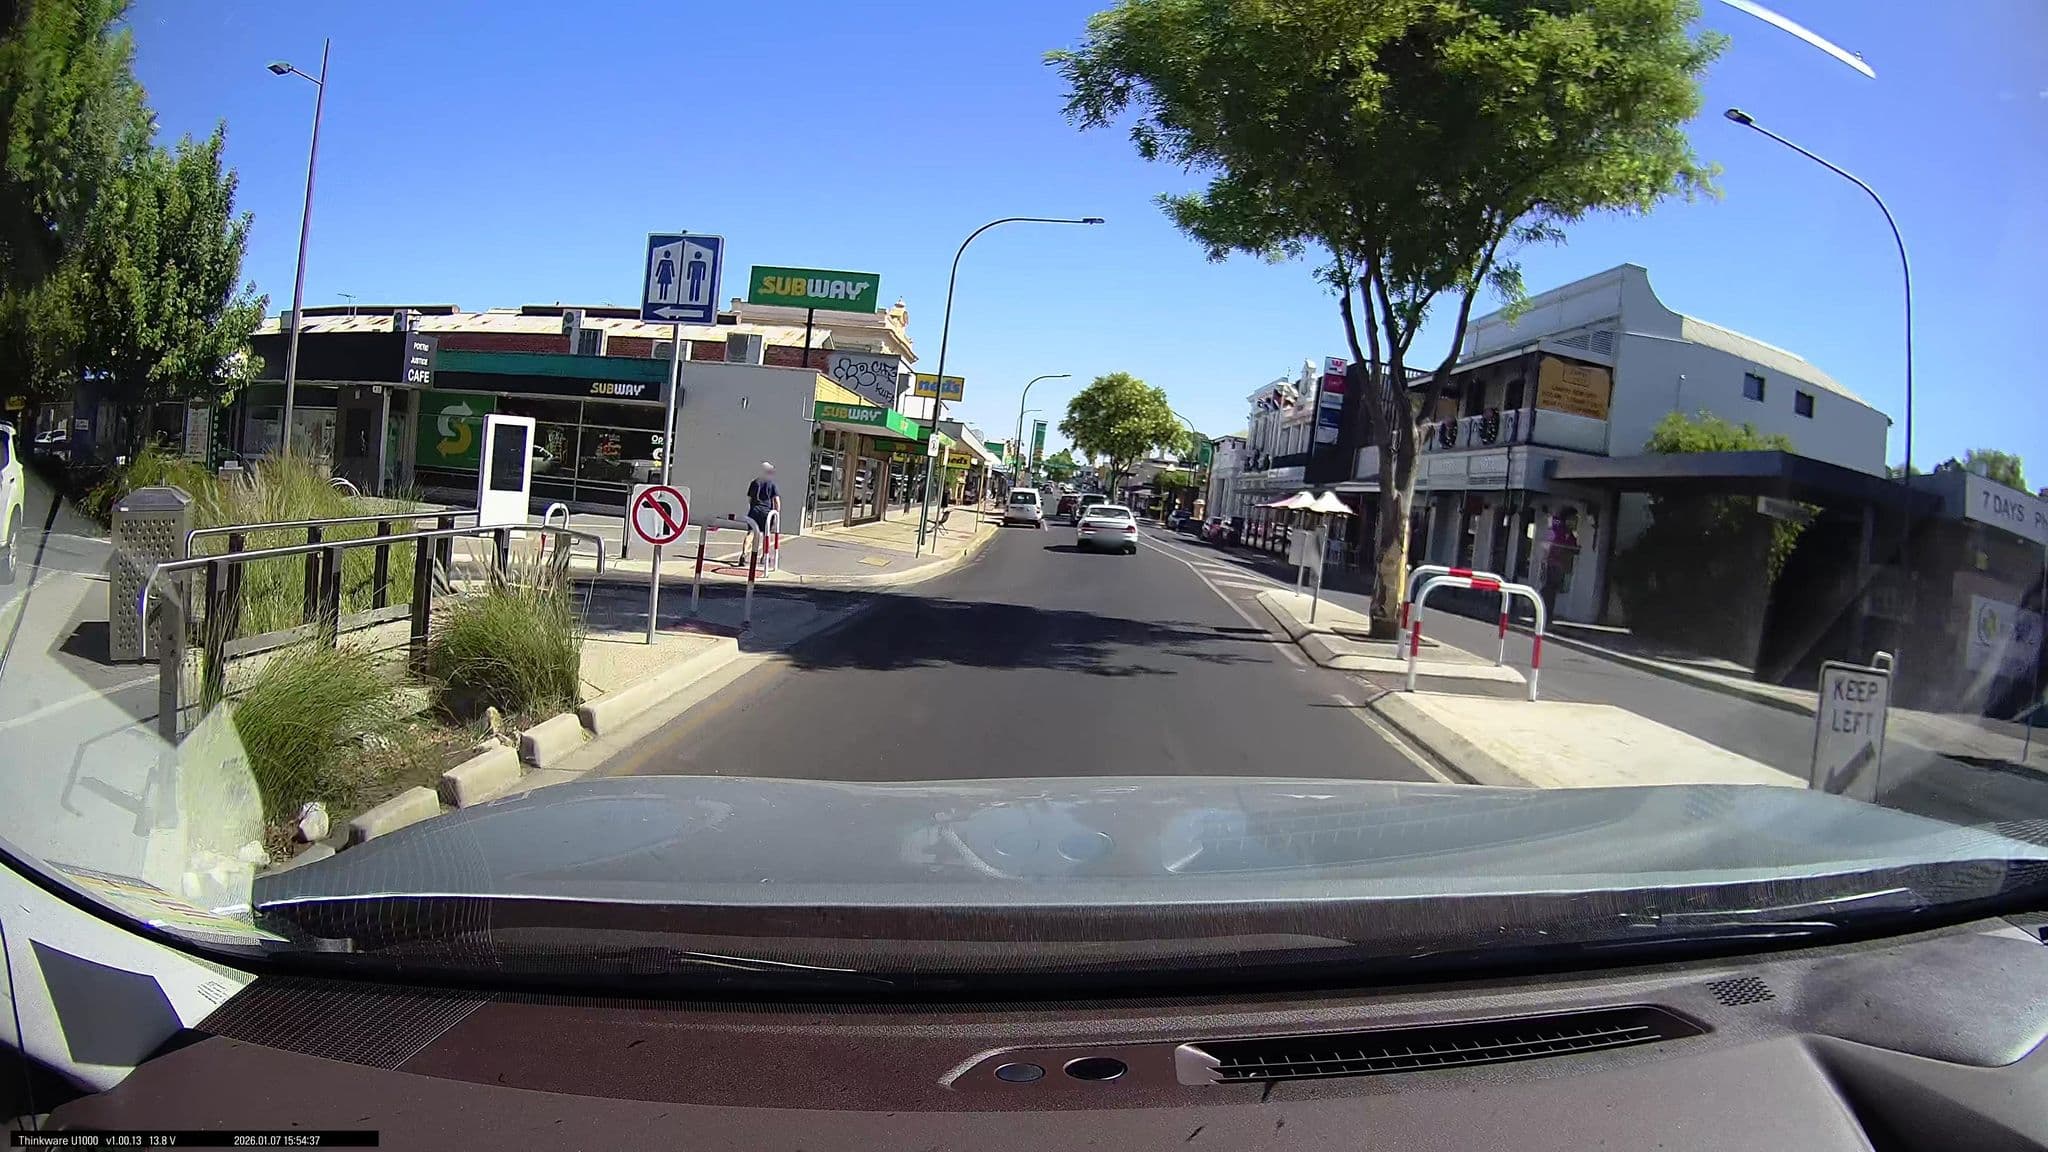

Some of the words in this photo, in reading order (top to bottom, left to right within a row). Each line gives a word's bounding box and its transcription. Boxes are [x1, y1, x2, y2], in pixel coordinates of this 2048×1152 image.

[758, 275, 870, 300] SUBWAY
[408, 368, 430, 383] CAFE
[590, 382, 645, 396] SUBWAY
[822, 407, 882, 422] SUBWAY
[1982, 490, 1990, 510] 7
[1993, 495, 2025, 523] DAYS
[1834, 679, 1878, 702] KEEP
[1832, 708, 1874, 735] LEFT
